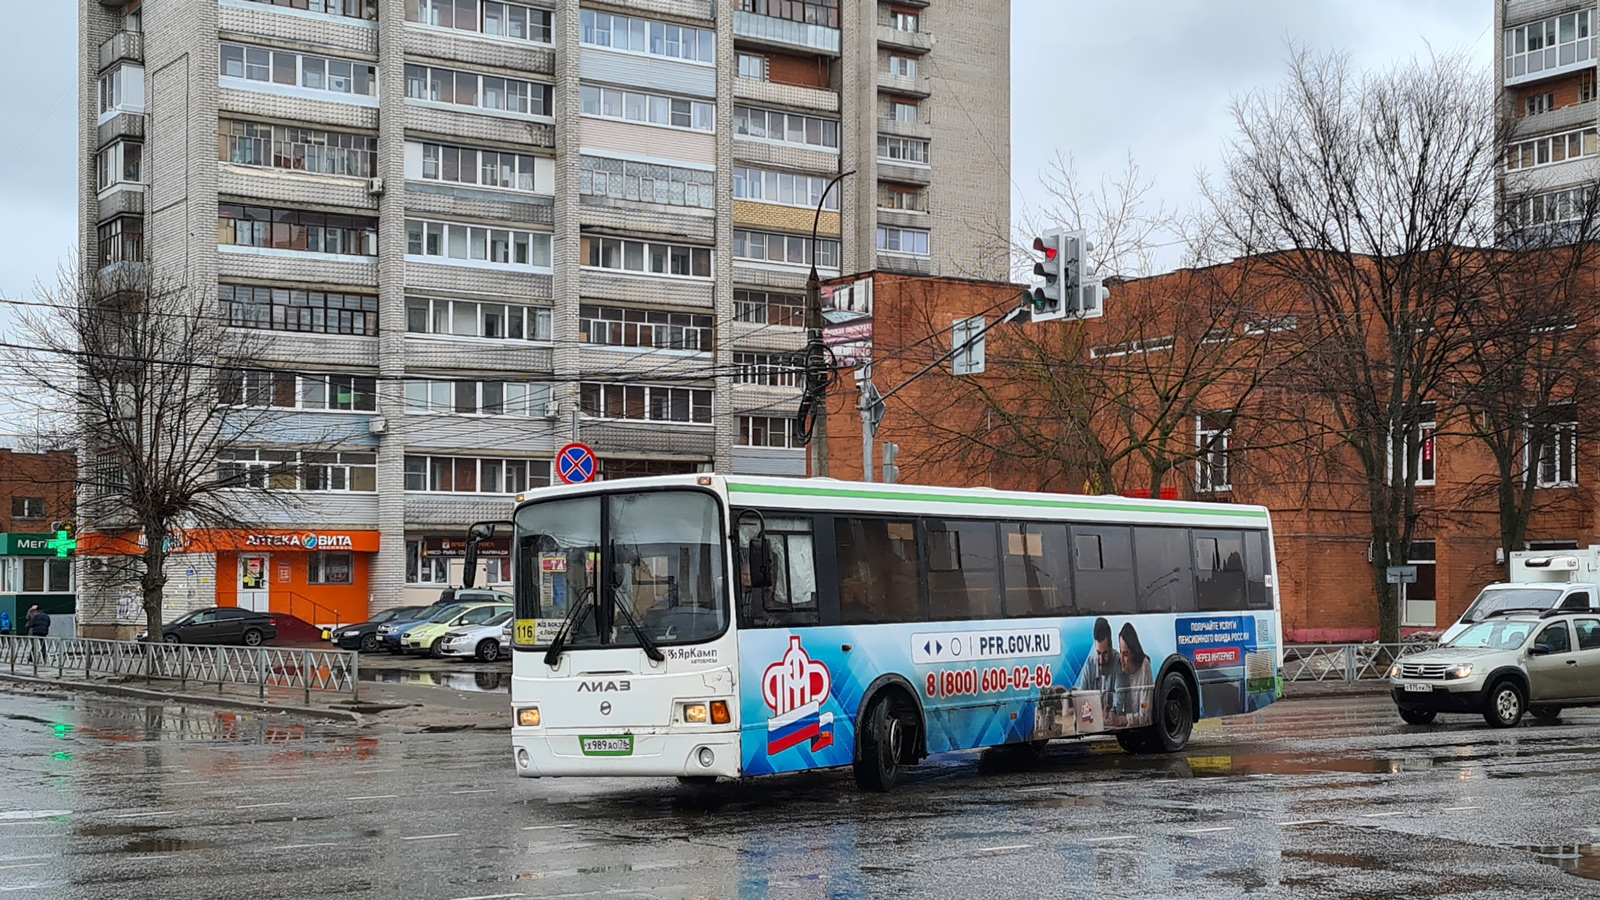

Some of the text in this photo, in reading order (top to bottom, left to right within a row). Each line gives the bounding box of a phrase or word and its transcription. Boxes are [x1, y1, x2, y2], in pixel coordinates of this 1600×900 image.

[17, 539, 47, 549] МЕГ
[246, 535, 352, 546] АПТЕКА ВИТА
[516, 625, 533, 638] 116
[1191, 620, 1237, 631] ПОЛУЧАЙТЕ УСЛУГИ
[1178, 632, 1249, 644] ПЕНСИОННОГО ФОНДА РОССИИ
[980, 634, 1050, 655] PFR.GOV.RU
[677, 648, 717, 661] ЯрКамп
[1195, 651, 1236, 663] ЧЕРЕЗ ИНТЕРНЕТ
[577, 681, 631, 692] ЛИАЗ
[926, 664, 1051, 698] 8 (800) 600-02-86
